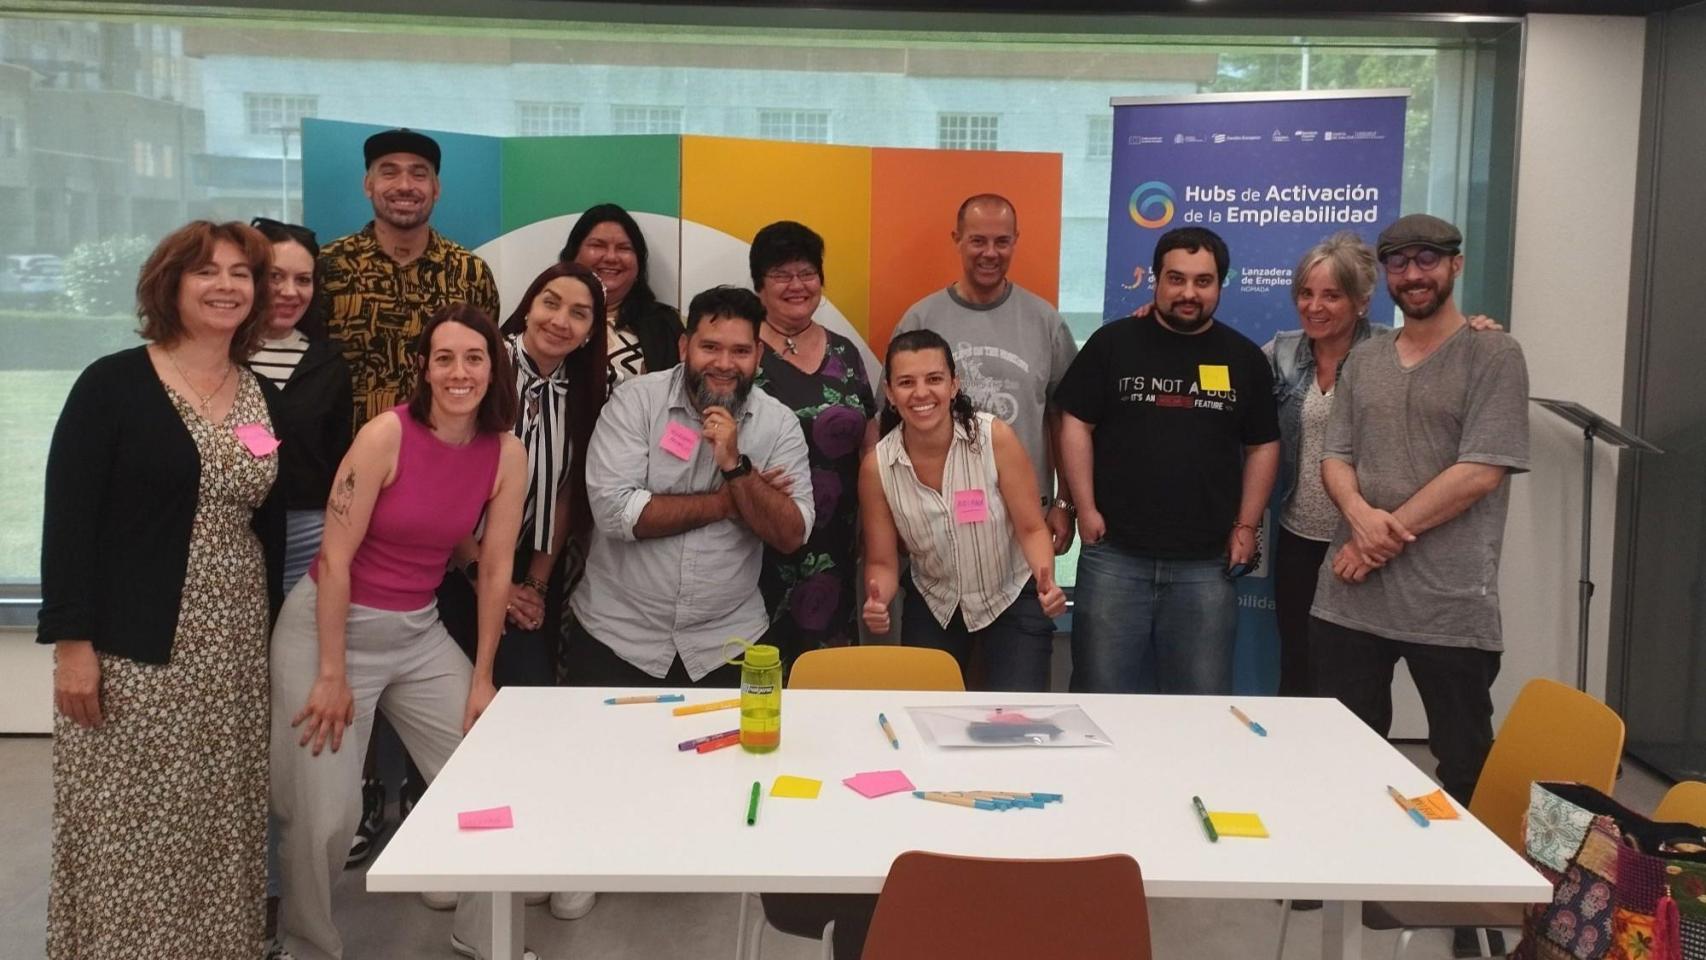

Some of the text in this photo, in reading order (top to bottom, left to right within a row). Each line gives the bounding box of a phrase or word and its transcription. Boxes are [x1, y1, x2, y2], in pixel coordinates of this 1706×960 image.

[1185, 184, 1379, 202] Hubs de Activación
[1184, 205, 1378, 226] de la Empleabilidad
[1242, 267, 1293, 276] Lanzadera
[1241, 276, 1293, 287] de Empleo
[1119, 376, 1145, 393] IT'S
[1151, 377, 1184, 393] NOT
[1188, 381, 1200, 396] A
[1130, 393, 1143, 402] IT'S
[1145, 394, 1156, 402] AN
[1194, 399, 1224, 411] FEATURE
